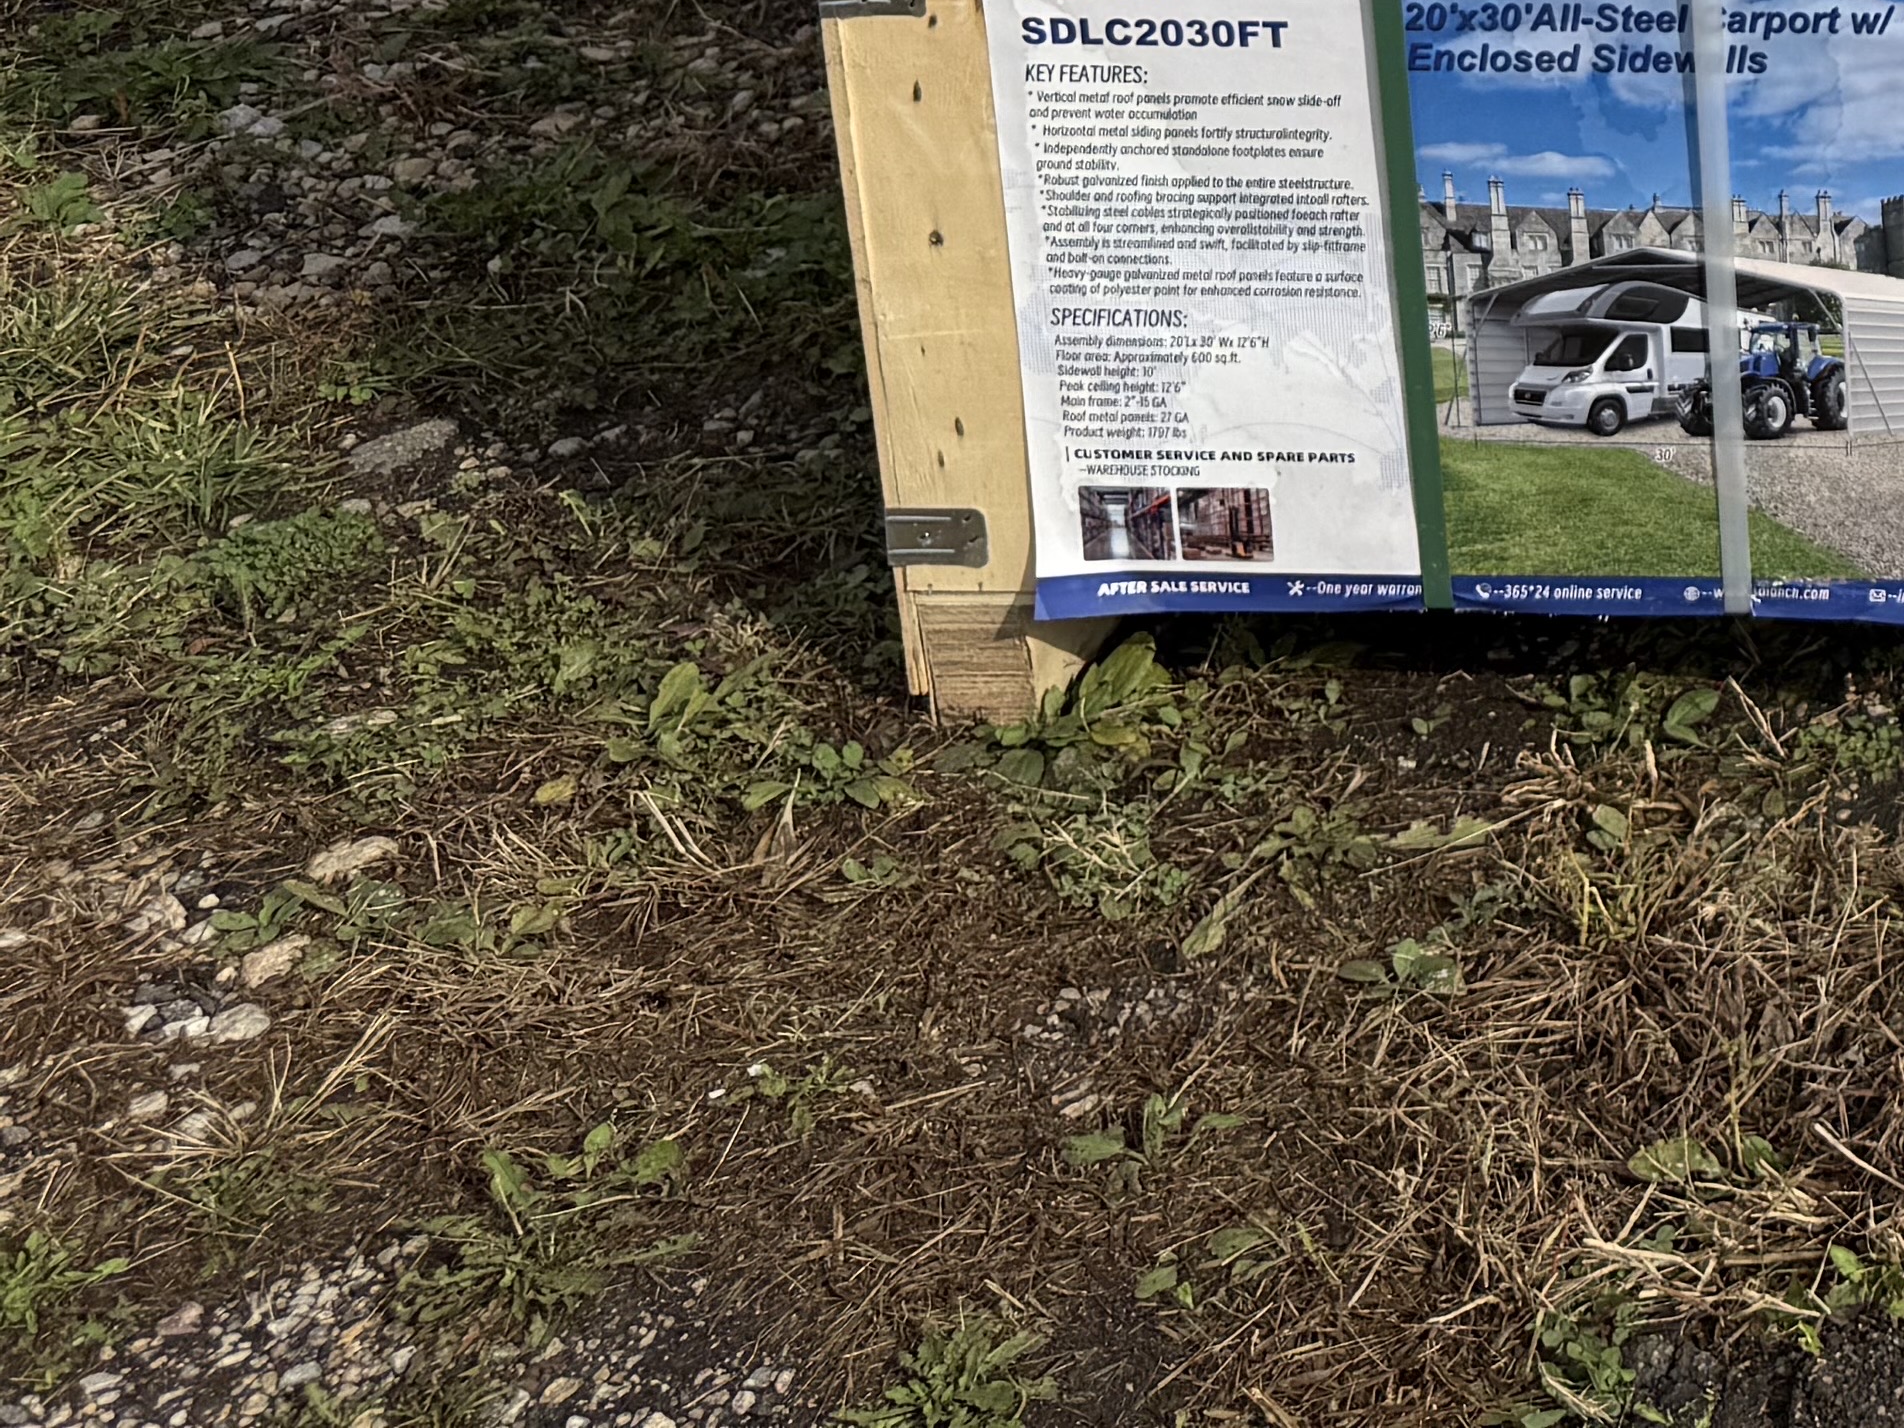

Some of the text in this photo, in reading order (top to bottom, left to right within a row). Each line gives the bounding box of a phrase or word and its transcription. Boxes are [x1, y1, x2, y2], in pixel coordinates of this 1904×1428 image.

[1721, 5, 1841, 40] arport
[1852, 5, 1895, 35] w/
[1021, 17, 1289, 48] SDLC2030FT
[1407, 43, 1768, 74] Enclosed Sidewlls
[1025, 64, 1148, 84] KEY FEATURES:
[1050, 307, 1188, 328] SPECIFICATIONS:
[1073, 448, 1356, 464] CUSTOMER SERVICE AND SPARE PARTS
[1655, 446, 1676, 463] 30'
[1097, 580, 1251, 596] AFTER SALE SERVICE
[1345, 583, 1373, 598] year
[1554, 585, 1592, 601] online
[1596, 586, 1642, 602] service
